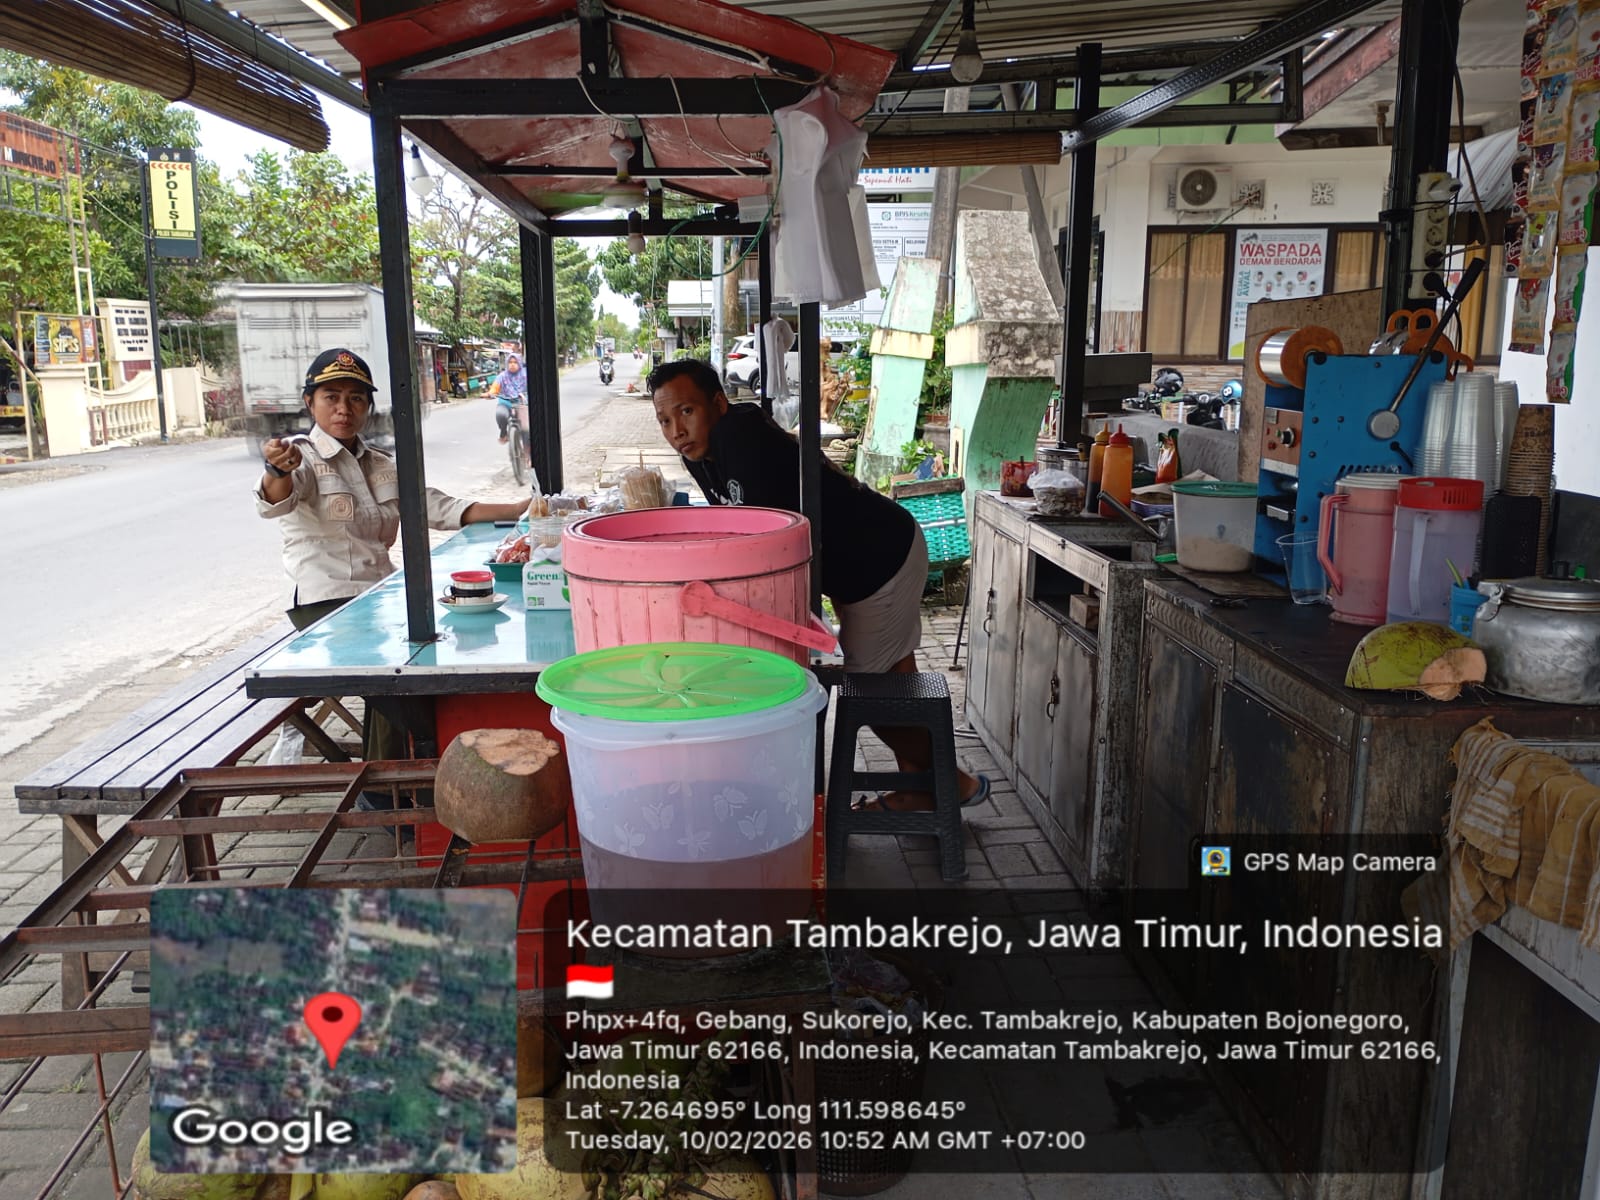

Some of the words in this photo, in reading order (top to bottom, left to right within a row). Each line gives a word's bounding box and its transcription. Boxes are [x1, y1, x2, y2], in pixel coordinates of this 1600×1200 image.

[895, 176, 912, 185] Hati
[166, 171, 179, 229] POLISI
[1240, 243, 1322, 257] WASPADA
[1240, 258, 1272, 266] DEMAM
[1274, 257, 1322, 265] BERDARAH
[1242, 270, 1251, 296] AWAL
[527, 571, 558, 580] Green
